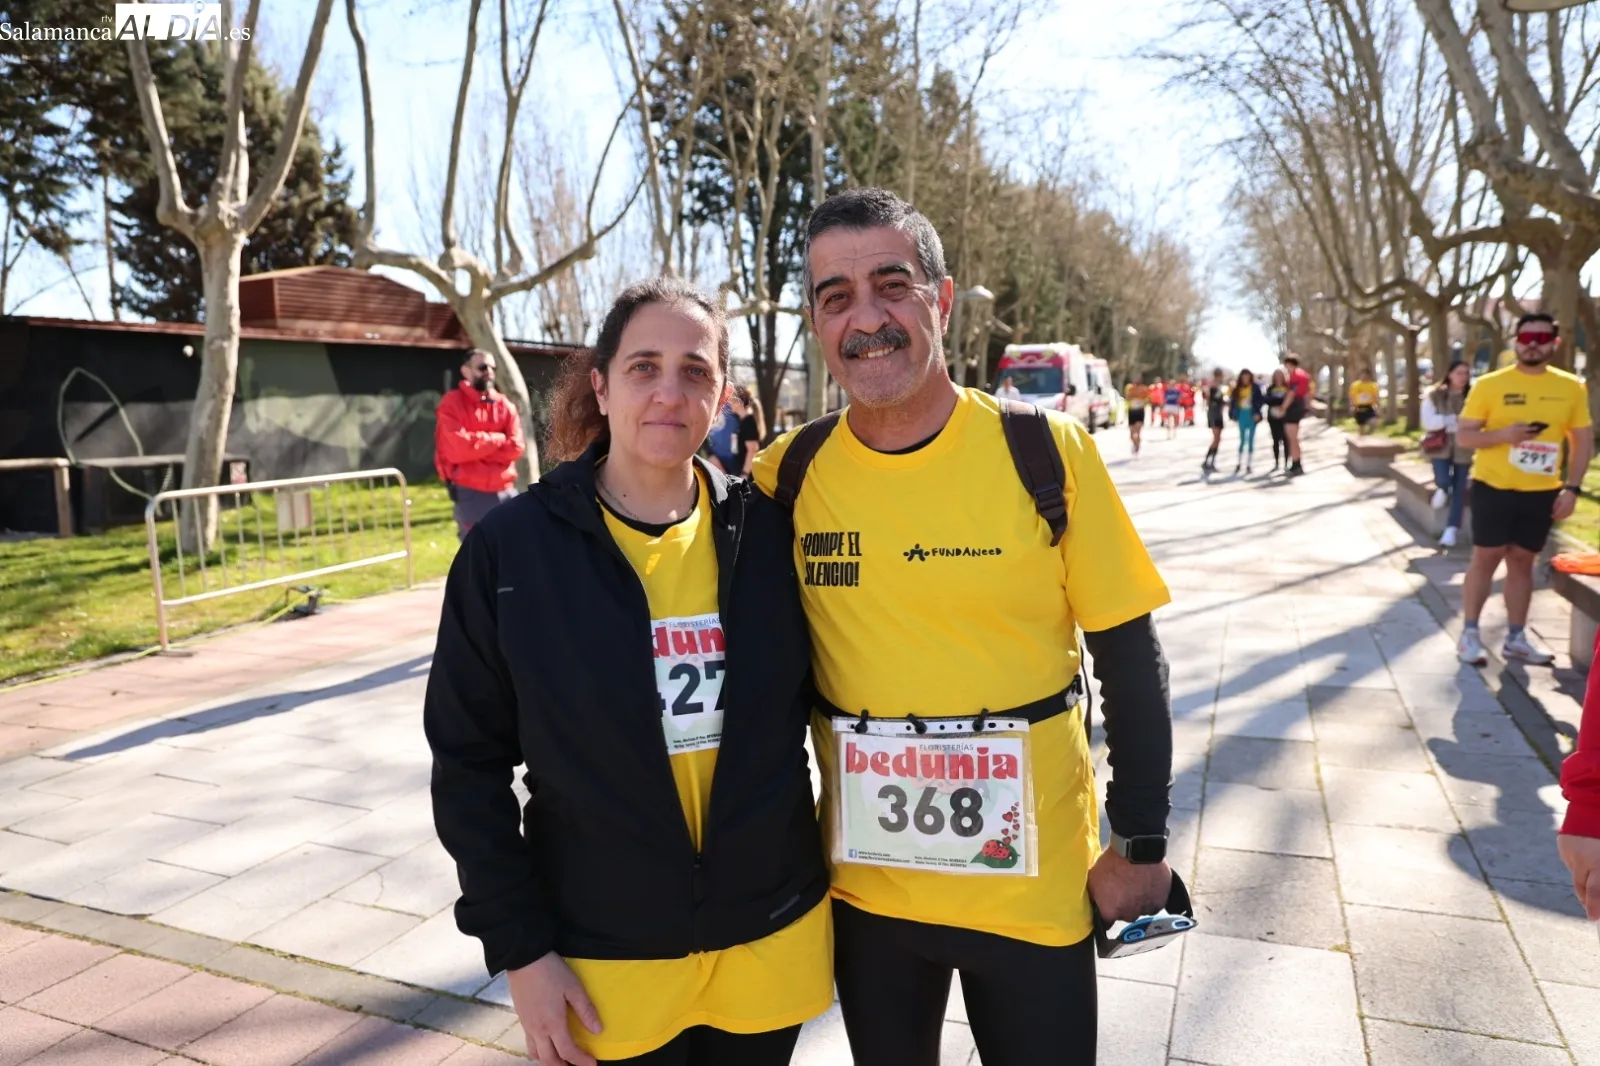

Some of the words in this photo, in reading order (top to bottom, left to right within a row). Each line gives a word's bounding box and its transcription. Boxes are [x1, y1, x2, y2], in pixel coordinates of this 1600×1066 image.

[1519, 451, 1547, 465] 291
[847, 531, 863, 557] EL
[651, 625, 726, 659] dun
[845, 741, 1019, 780] bedunia
[918, 742, 975, 753] FLORISTERÍAS
[876, 784, 985, 838] 368
